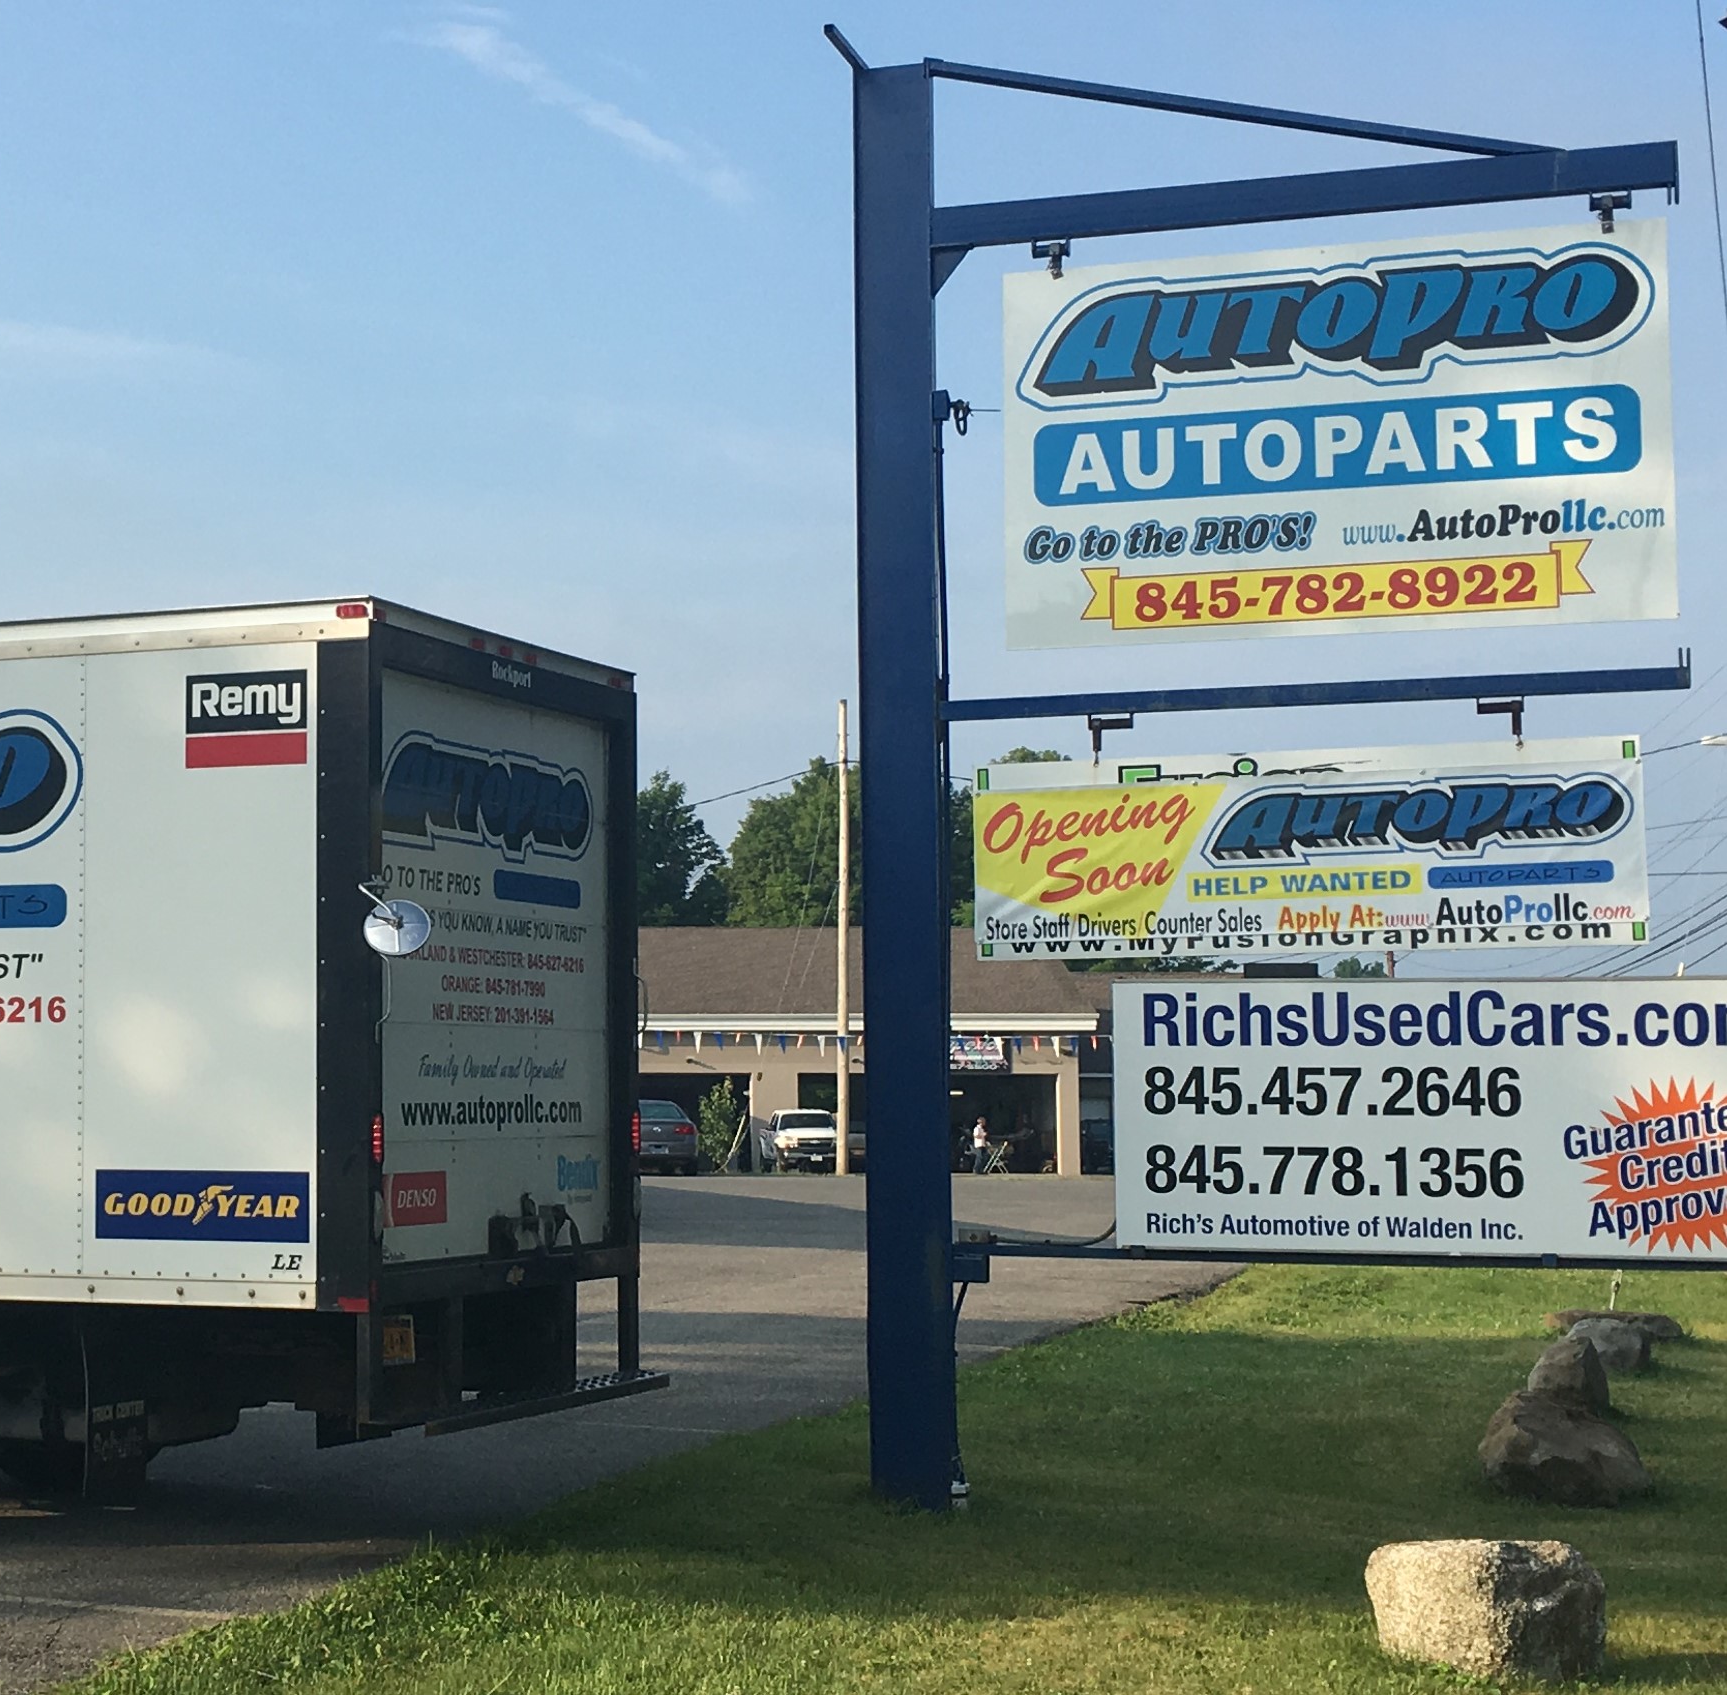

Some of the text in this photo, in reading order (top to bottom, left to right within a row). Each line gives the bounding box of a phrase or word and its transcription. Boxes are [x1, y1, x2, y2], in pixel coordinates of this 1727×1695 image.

[1058, 396, 1618, 496] AUTOPARTS
[1025, 511, 1317, 563] Go to the PRO'S!
[1342, 499, 1666, 547] www.AutoProllc.com
[1133, 561, 1538, 624] 845-782-8922
[492, 660, 531, 688] Rockport
[191, 681, 302, 725] Remy
[982, 793, 1196, 864] Opening
[397, 865, 415, 890] TO
[419, 867, 444, 894] THE
[447, 871, 482, 896] PRO'S
[1039, 847, 1174, 903] Soon
[1193, 870, 1412, 897] HELP WANTED
[1440, 866, 1601, 885] AUTOPARTS
[496, 917, 506, 934] A
[505, 919, 533, 938] NAME
[986, 915, 1028, 941] Store
[1218, 906, 1263, 933] Sales
[1278, 904, 1341, 934] Apply
[1142, 989, 1727, 1048] RichsUsedCars.co
[1144, 1065, 1522, 1118] 845.457.2646
[400, 1093, 582, 1132] www.autoprollc.com
[1145, 1144, 1524, 1200] 845.778.1356
[104, 1190, 301, 1219] GOODYEAR
[397, 1188, 437, 1209] DENSO
[1146, 1212, 1524, 1242] Rich's Automotive of Walden Inc.
[271, 1253, 303, 1271] LE
